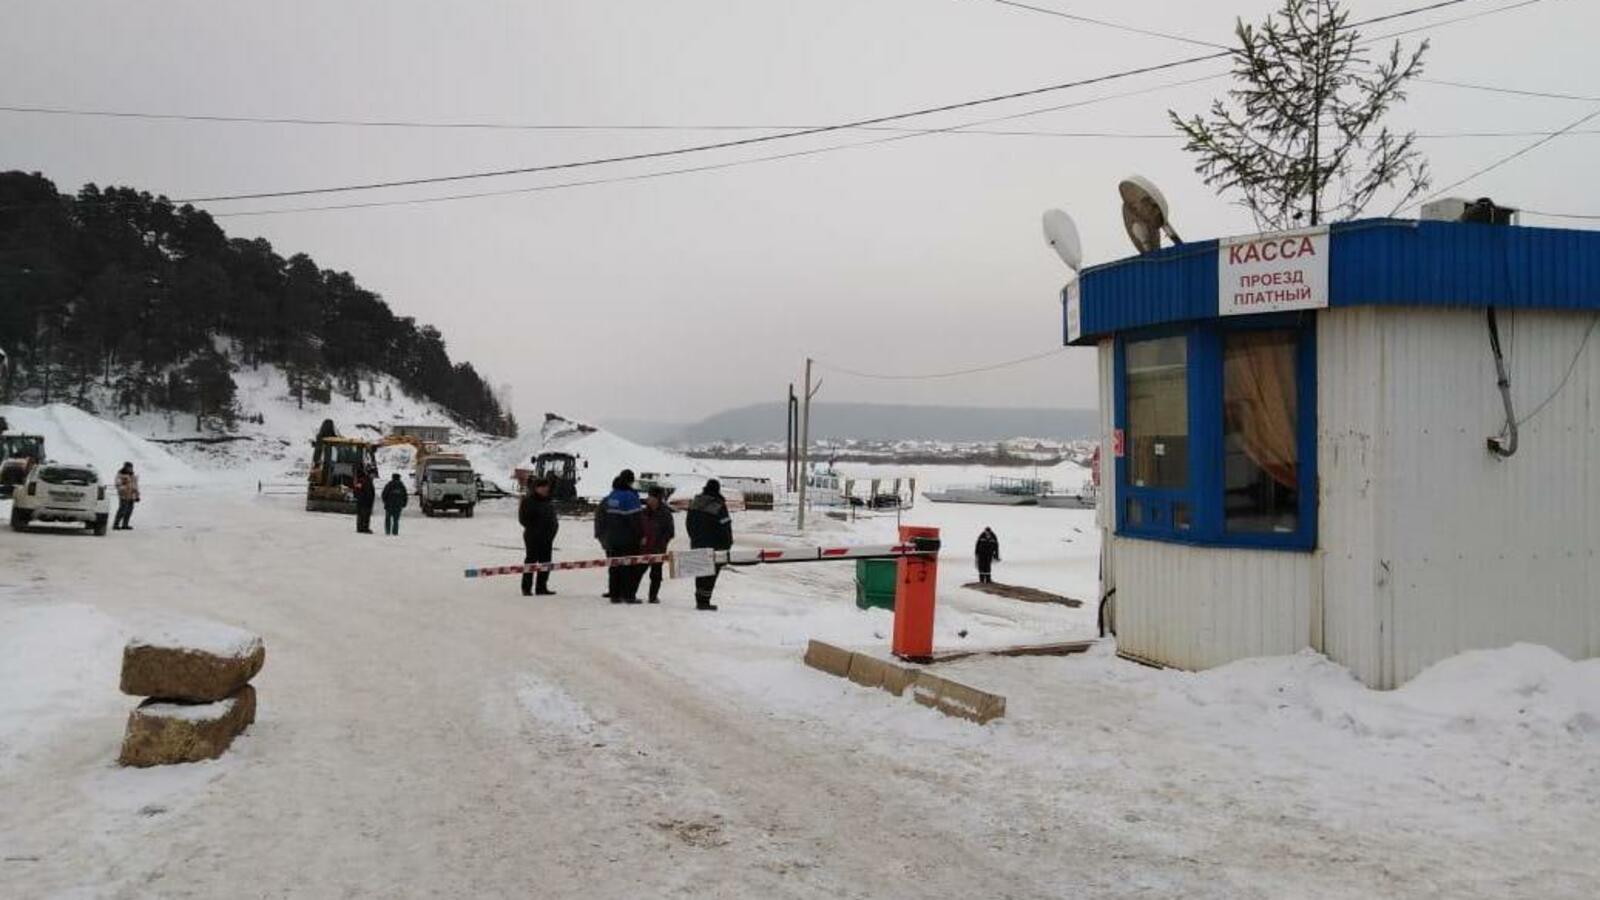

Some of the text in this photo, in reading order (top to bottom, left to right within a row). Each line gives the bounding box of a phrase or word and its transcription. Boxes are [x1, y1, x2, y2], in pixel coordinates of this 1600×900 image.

[1229, 235, 1316, 265] КАССА
[1240, 270, 1304, 287] ПРОЕЗД
[1234, 286, 1312, 305] ПЛАТНЫЙ
